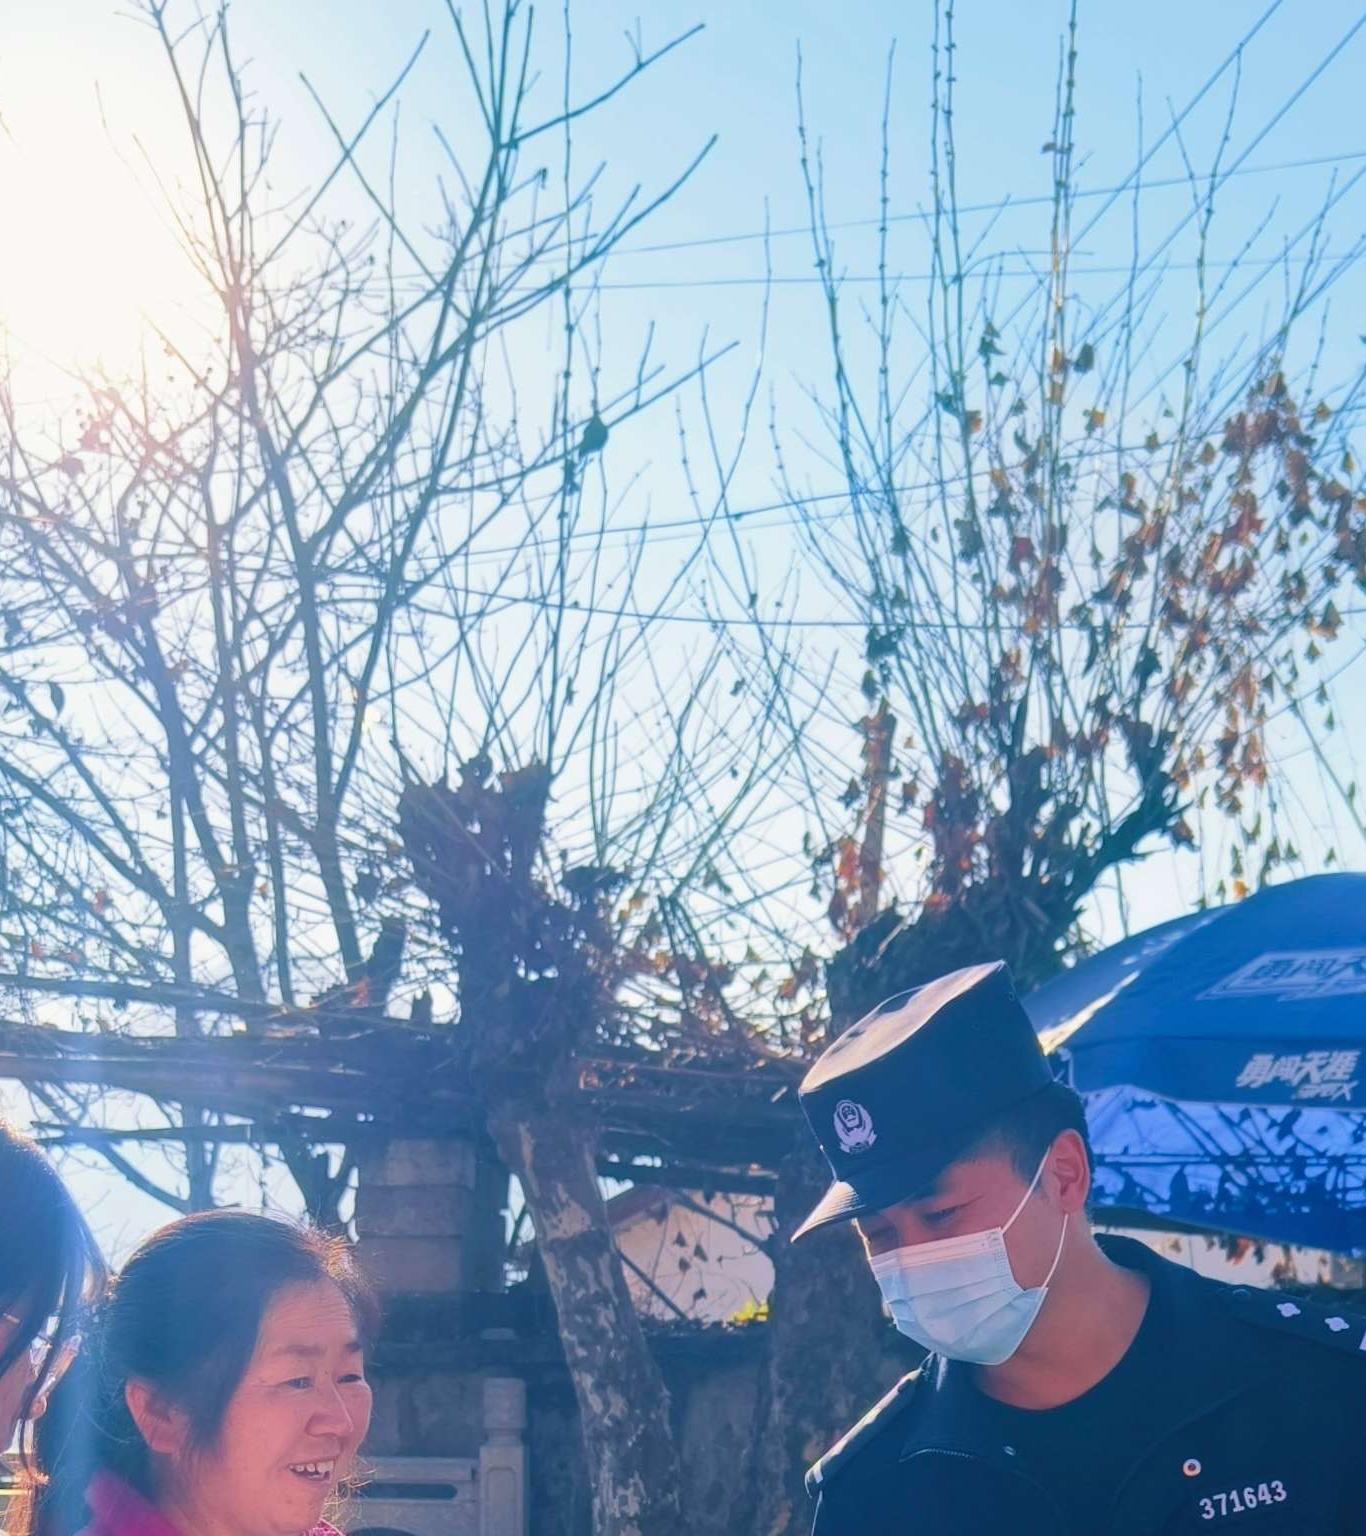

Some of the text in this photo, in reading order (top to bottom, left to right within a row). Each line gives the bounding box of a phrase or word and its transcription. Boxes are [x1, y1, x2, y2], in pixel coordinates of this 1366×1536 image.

[1236, 1050, 1361, 1088] 勇闯天涯
[1199, 1480, 1287, 1520] 371643
